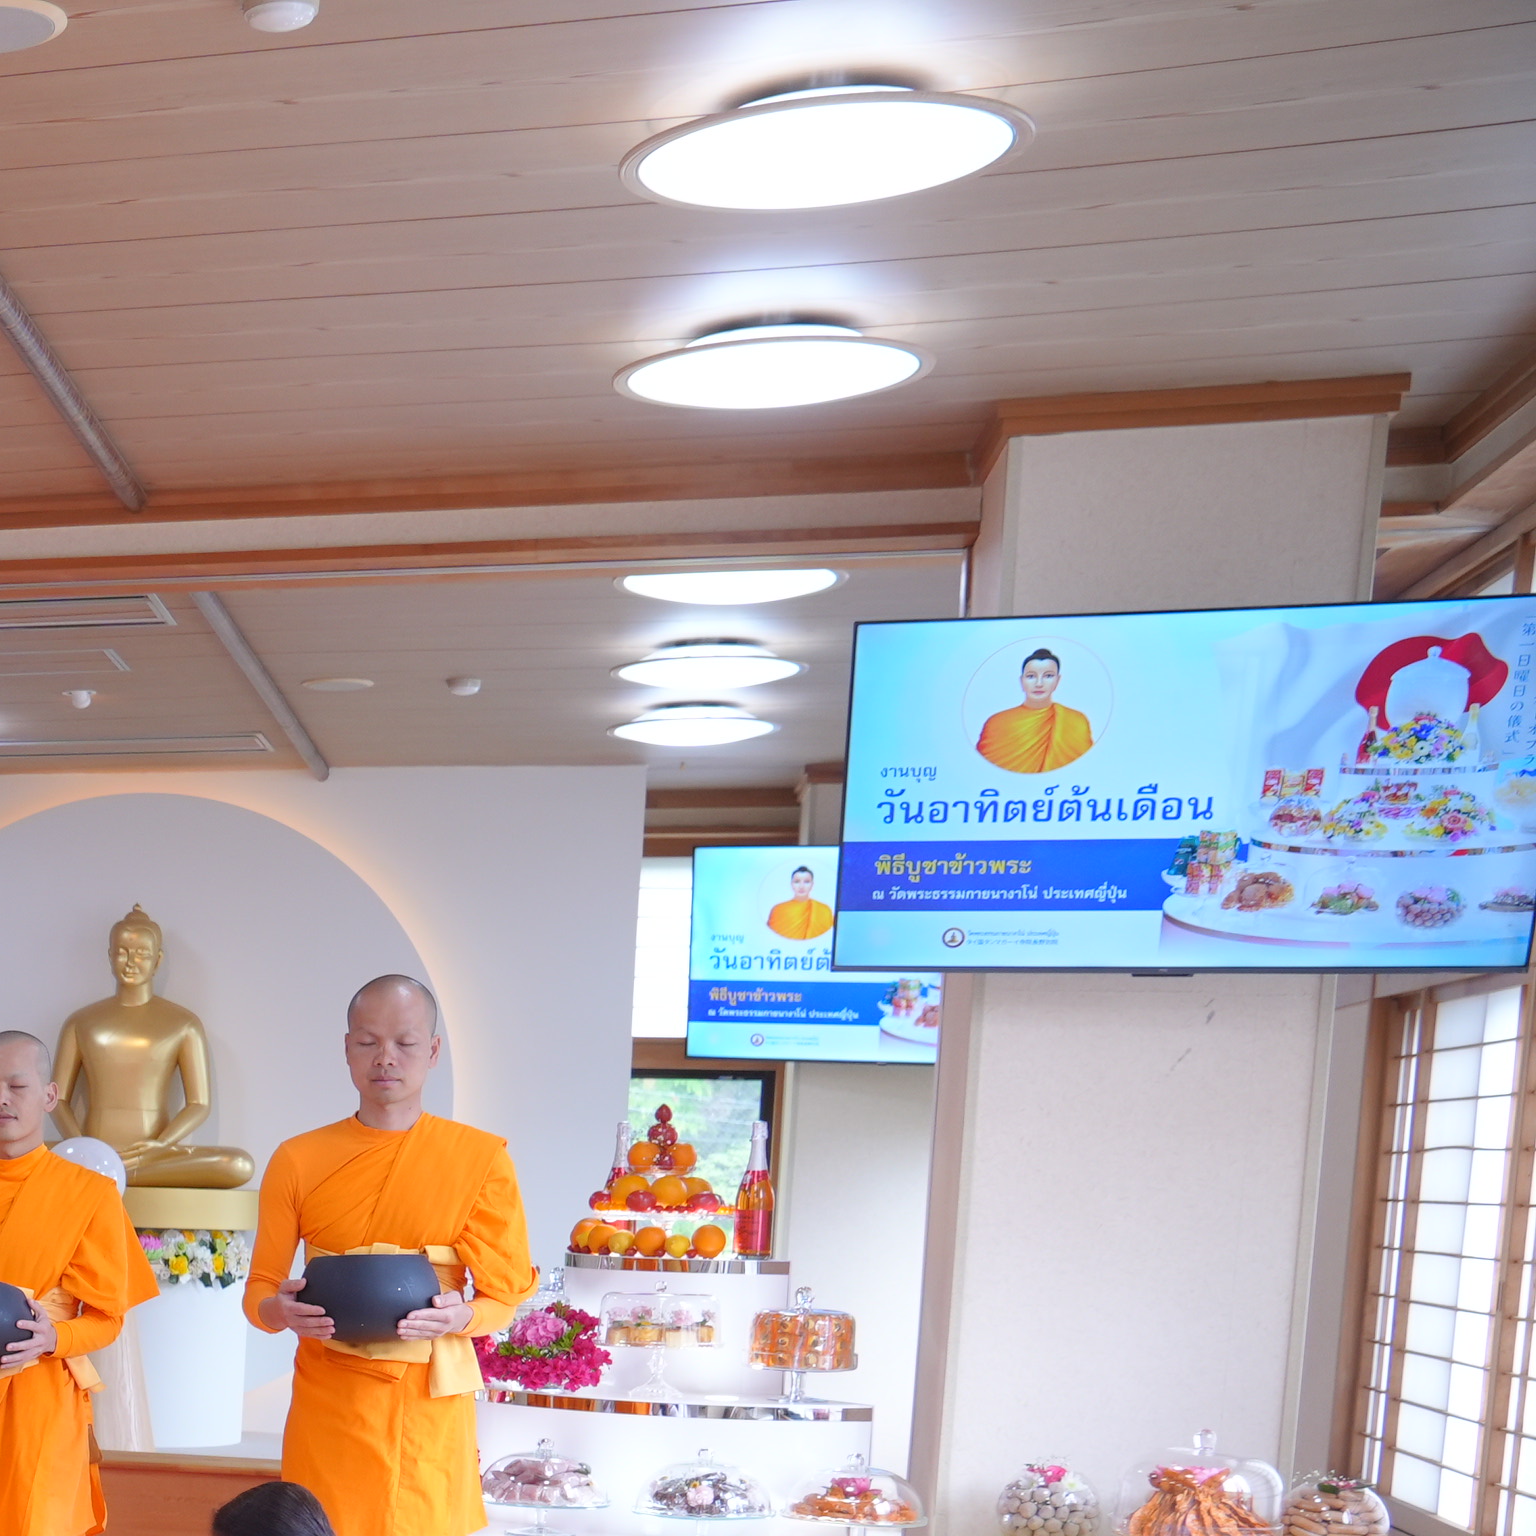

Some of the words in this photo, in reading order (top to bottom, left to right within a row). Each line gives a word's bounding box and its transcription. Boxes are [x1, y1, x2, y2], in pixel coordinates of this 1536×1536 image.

[880, 765, 937, 783] งานบุญ
[877, 783, 1214, 825] วันอาทิตย์ต้นเดือน
[874, 853, 1032, 883] พิธีบูชาข้าวพระ
[872, 889, 884, 901] ณ
[889, 884, 1038, 901] วัดพระธรรมกายนางาโน่
[1043, 881, 1128, 903] ประเทศญี่ปุ่น
